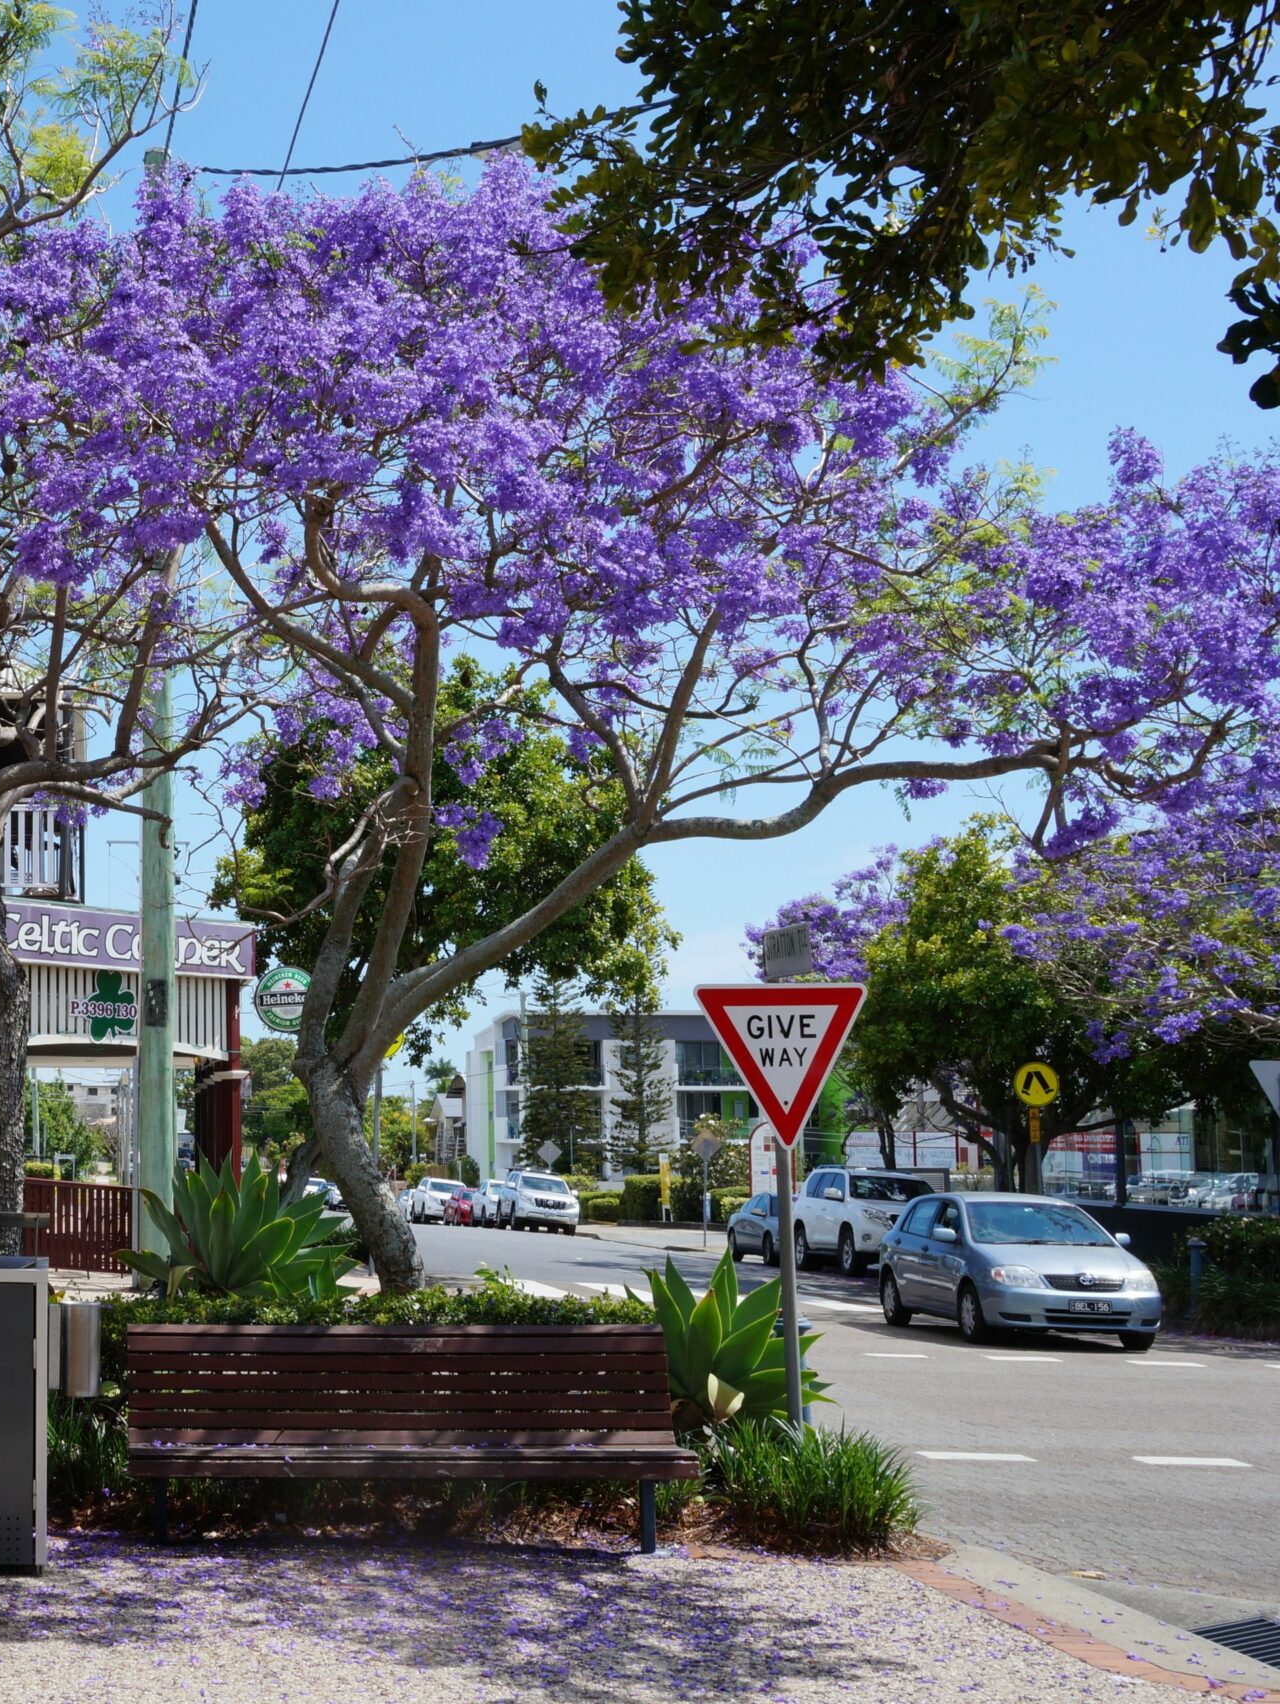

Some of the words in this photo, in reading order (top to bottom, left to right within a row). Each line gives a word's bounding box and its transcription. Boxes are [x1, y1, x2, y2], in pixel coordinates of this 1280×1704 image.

[6, 912, 100, 958] Celtic
[70, 1001, 113, 1017] P.3396
[746, 1014, 817, 1040] GIVE
[759, 1047, 807, 1067] WAY
